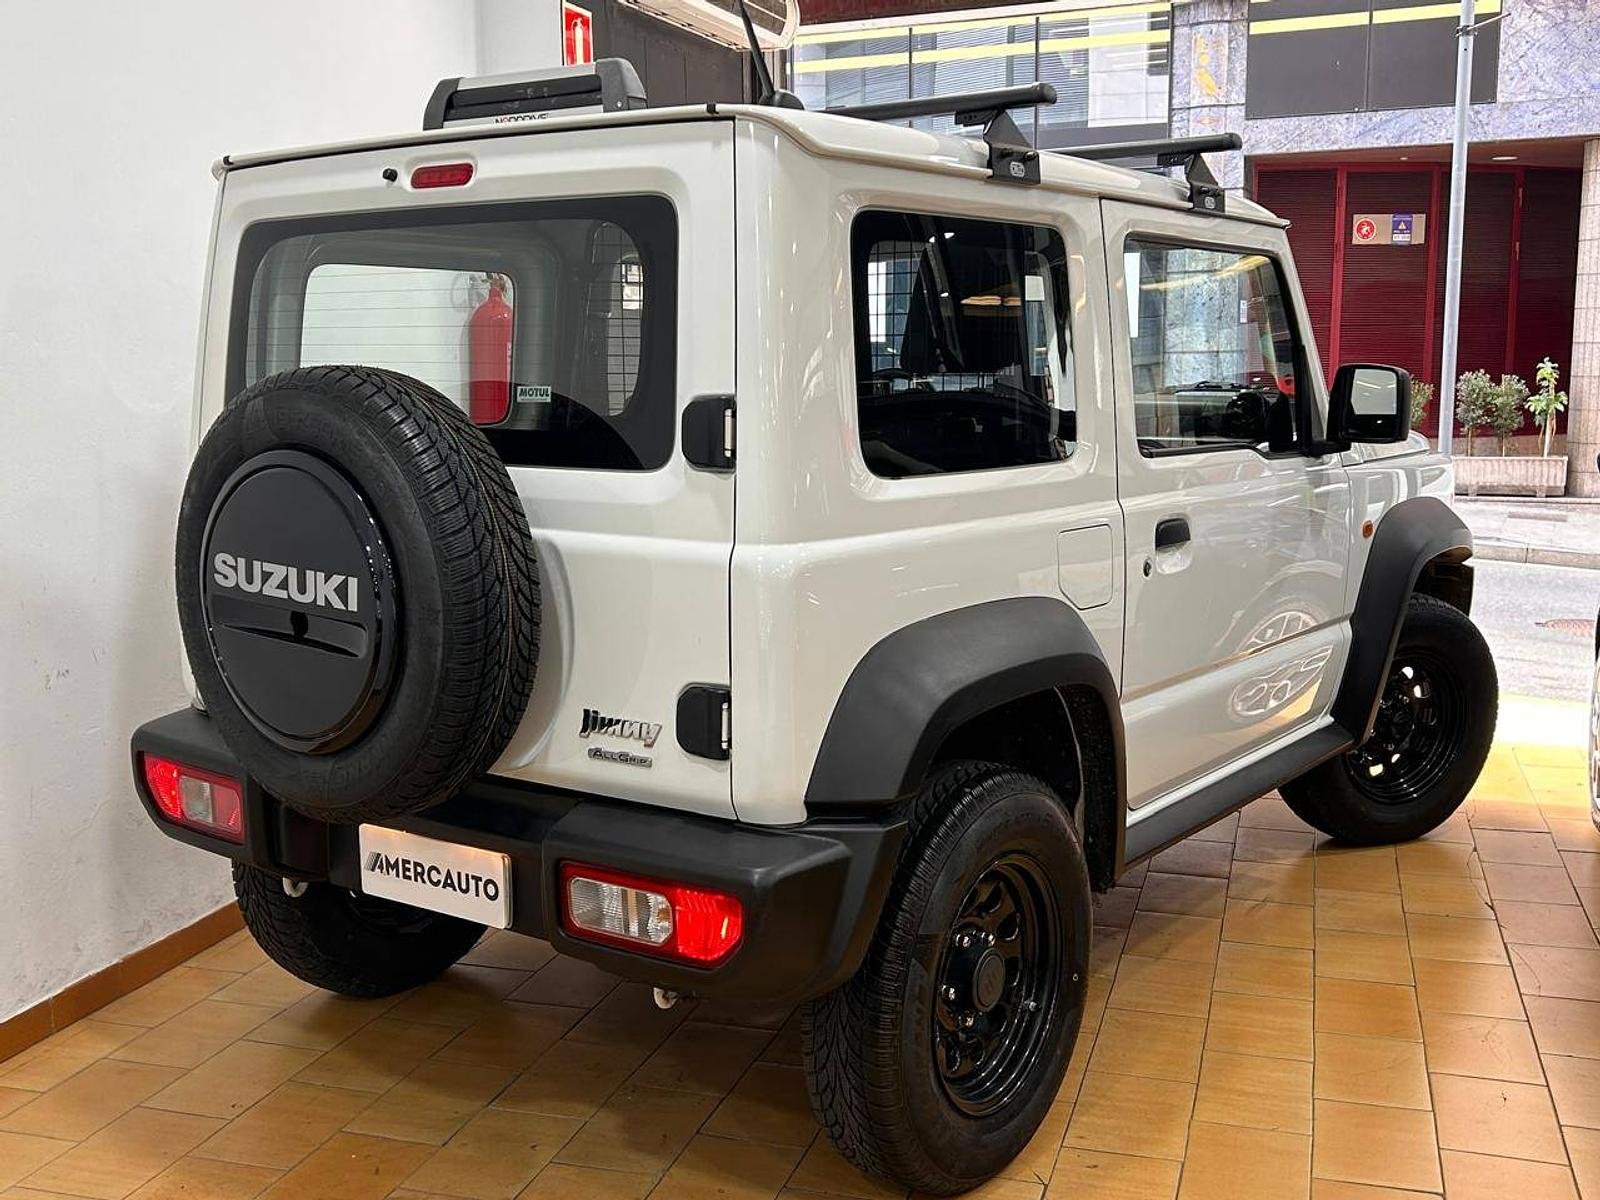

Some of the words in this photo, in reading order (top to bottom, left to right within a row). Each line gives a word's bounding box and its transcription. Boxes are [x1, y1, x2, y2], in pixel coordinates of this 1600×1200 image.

[519, 388, 549, 398] MOTUL
[213, 552, 358, 612] SUZUKI
[579, 708, 662, 748] Jimny
[364, 851, 499, 901] AMERCAUTO
